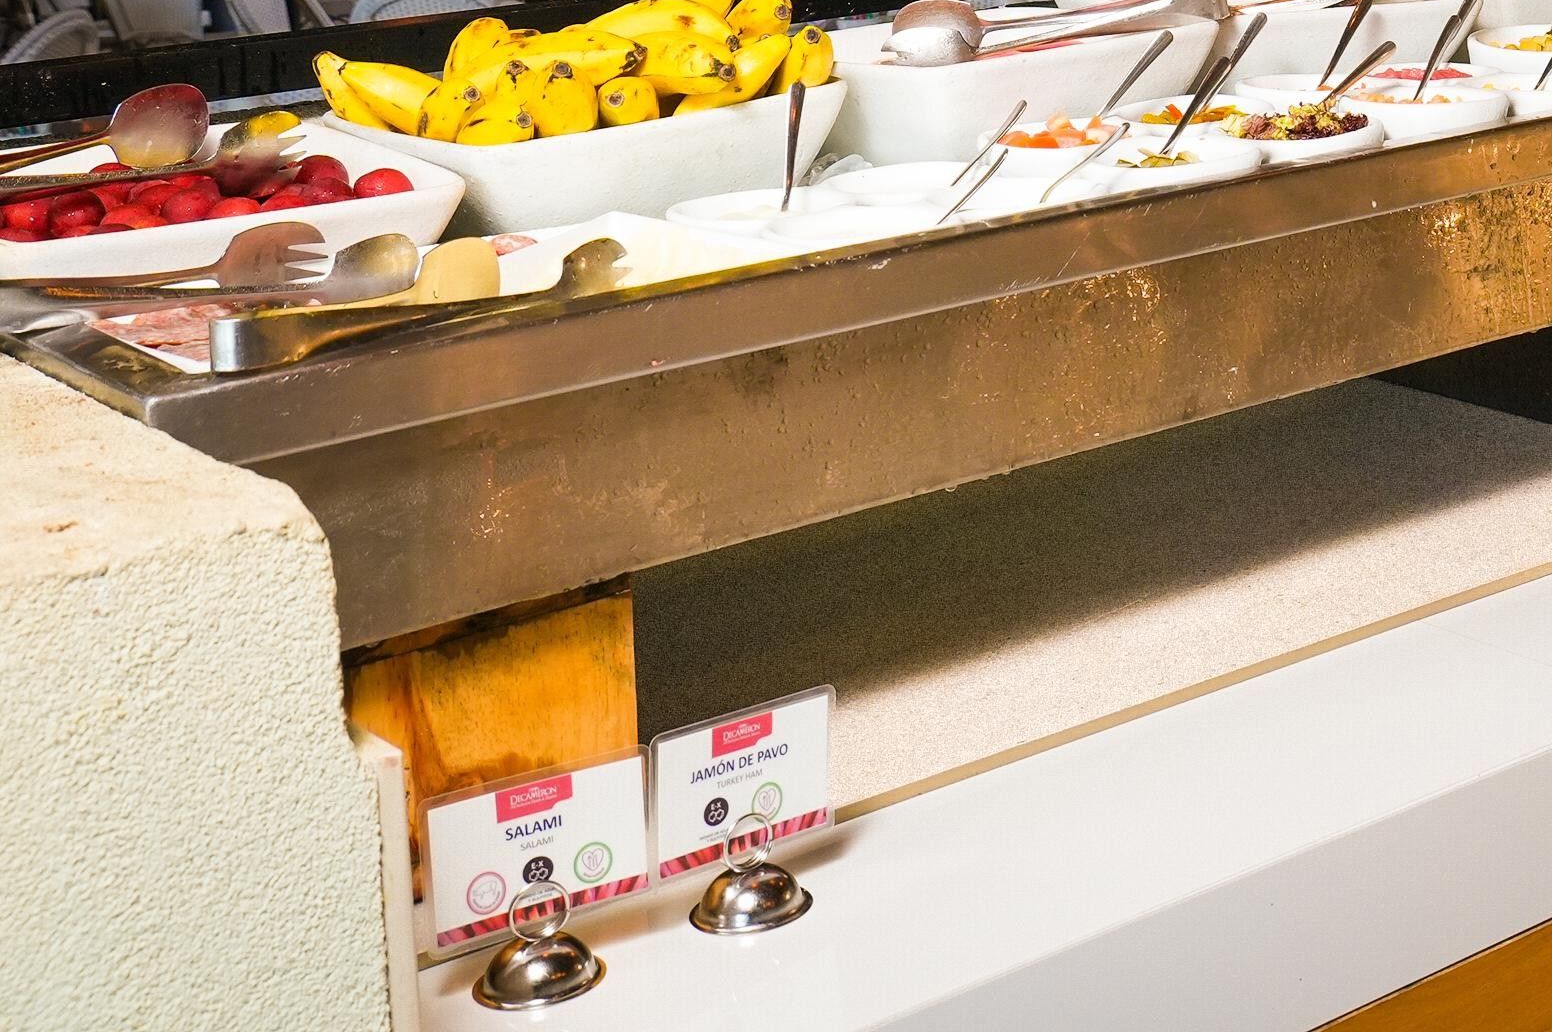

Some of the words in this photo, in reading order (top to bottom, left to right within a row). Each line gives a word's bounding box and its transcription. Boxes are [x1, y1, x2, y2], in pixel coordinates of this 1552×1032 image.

[690, 759, 735, 784] JAMÓN
[738, 753, 754, 769] DE
[757, 743, 789, 763] PAVO
[717, 774, 743, 789] TURKEY
[745, 768, 763, 780] HAM
[510, 786, 558, 806] DECAMERON
[505, 814, 562, 842] SALAMI
[520, 835, 554, 852] SALAMI
